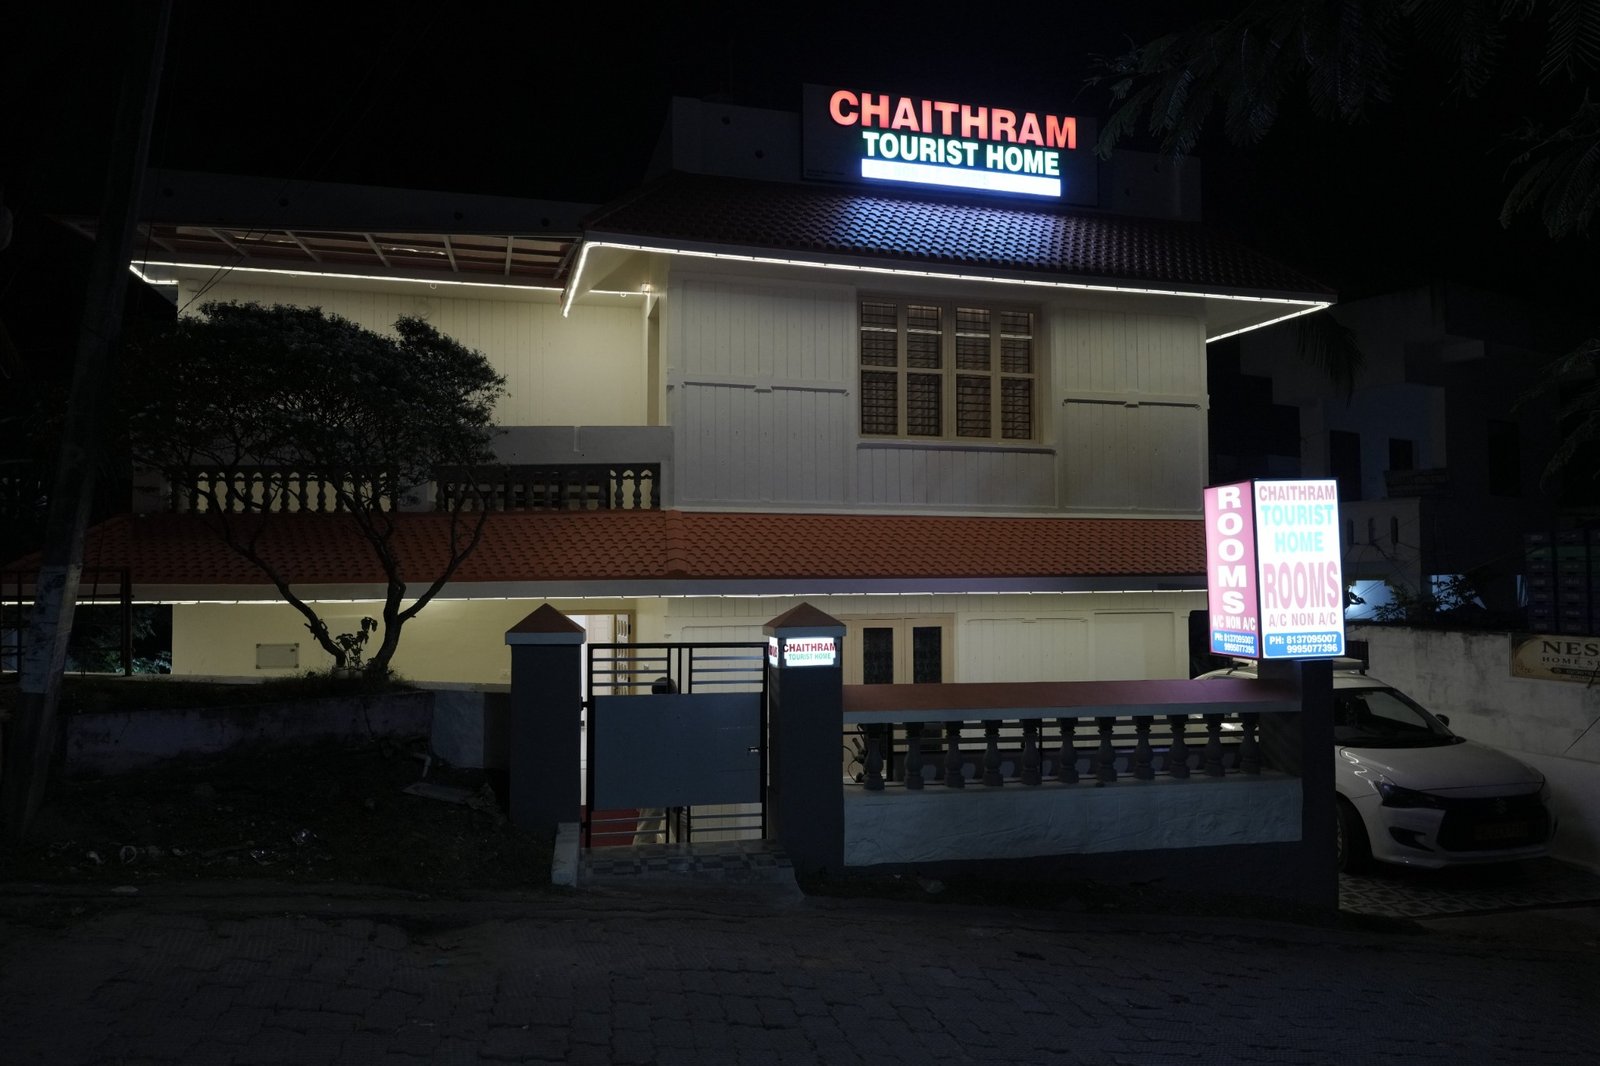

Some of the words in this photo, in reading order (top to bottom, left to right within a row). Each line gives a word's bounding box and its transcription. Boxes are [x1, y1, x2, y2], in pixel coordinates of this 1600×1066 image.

[829, 89, 1077, 150] CHAITHRAM
[862, 130, 979, 167] TOURIST
[986, 144, 1060, 176] HOME
[1258, 484, 1336, 502] CHAITHRAM
[1260, 503, 1335, 527] TOURIST
[1216, 485, 1248, 615] ROOMS
[1274, 531, 1325, 554] HOME
[1262, 560, 1339, 610] ROOMS
[1268, 612, 1287, 628] A/C
[1291, 612, 1315, 627] NON
[1318, 611, 1337, 626] A/C
[783, 642, 837, 653] CHAITHRAM
[1269, 635, 1285, 645] PH:
[1286, 633, 1337, 644] 8137095007
[1286, 643, 1338, 654] 9995077396
[788, 653, 813, 661] TOURIST
[814, 652, 831, 660] HOME
